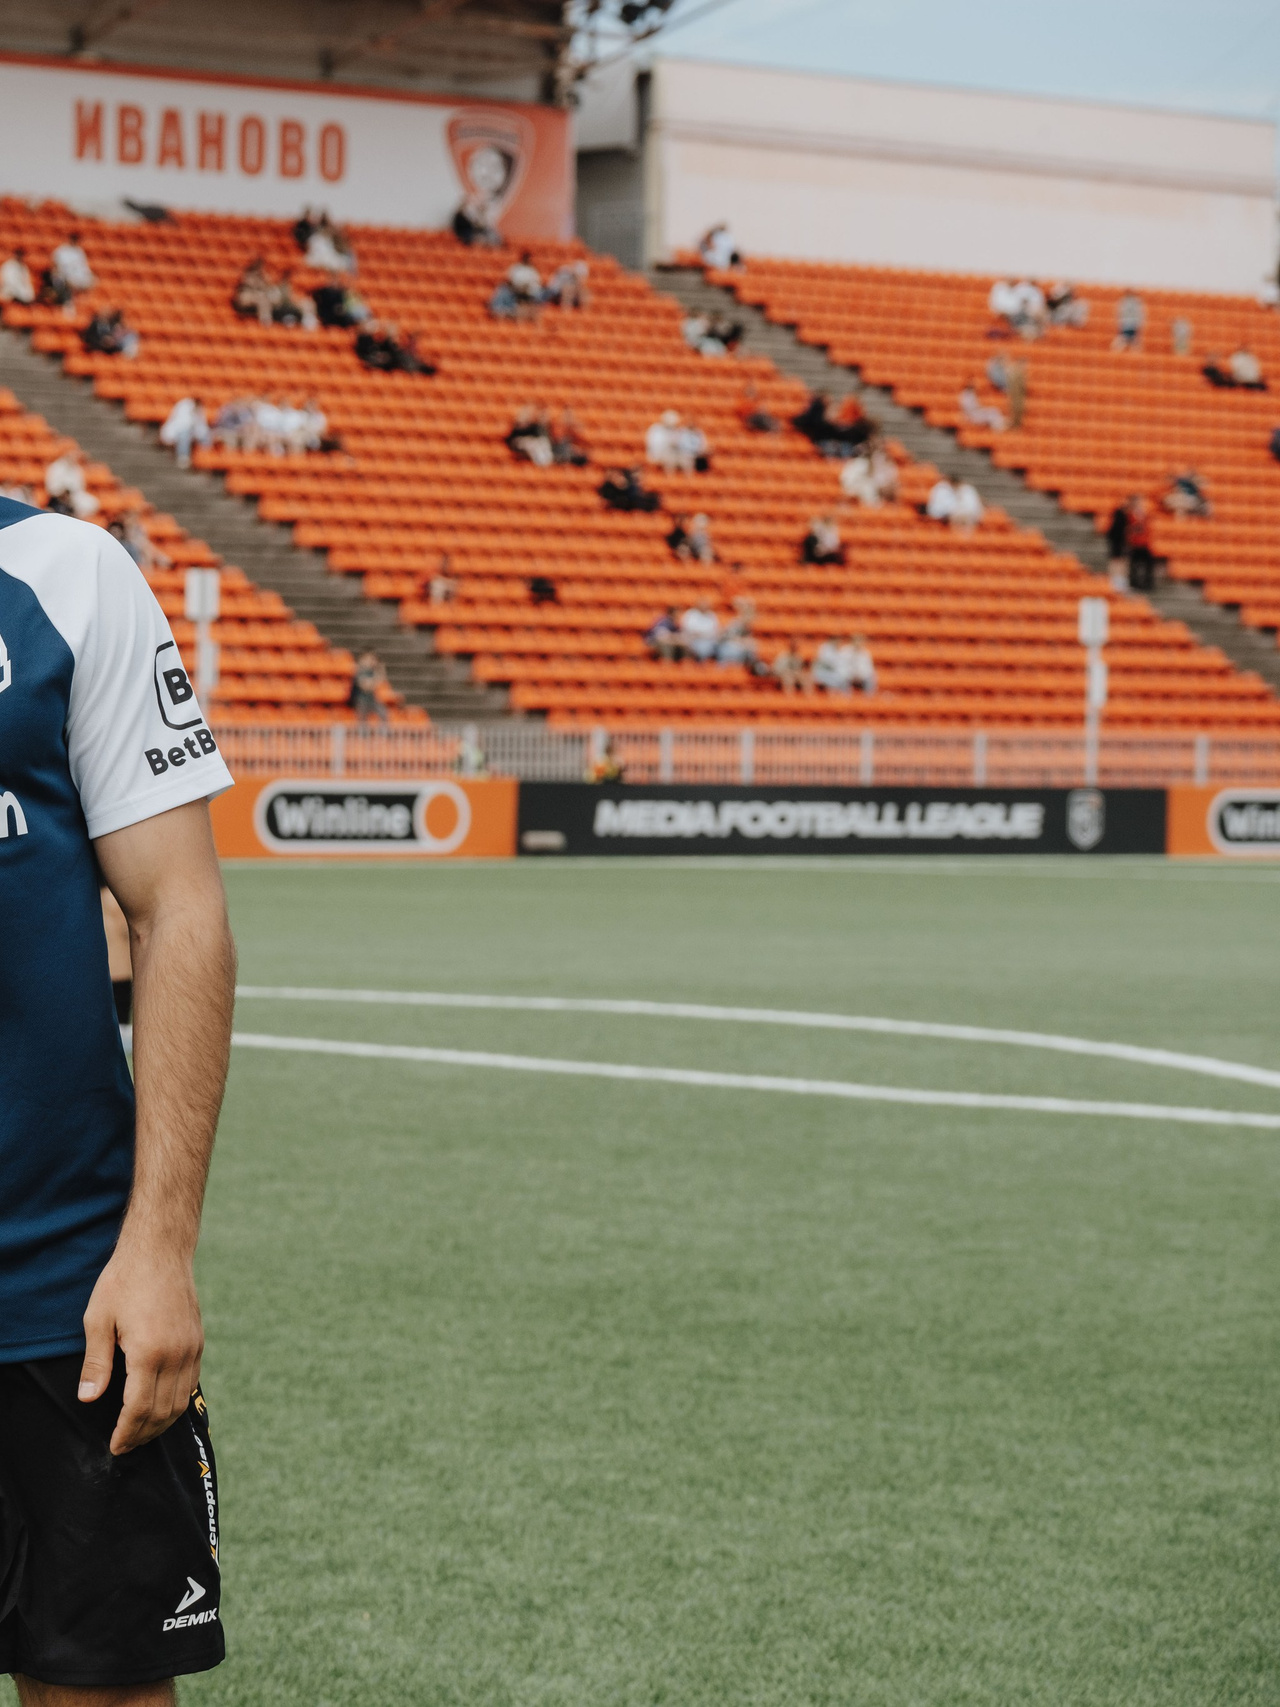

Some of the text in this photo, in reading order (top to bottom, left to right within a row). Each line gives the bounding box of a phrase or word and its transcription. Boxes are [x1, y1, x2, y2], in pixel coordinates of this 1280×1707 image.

[75, 97, 346, 184] ИВАНОВО
[162, 668, 194, 705] B
[272, 795, 411, 838] Winline
[592, 799, 717, 838] MEDIA
[709, 800, 901, 839] FOOTBALL
[903, 801, 1045, 839] LEAGUE
[162, 1607, 218, 1632] DEMIX
